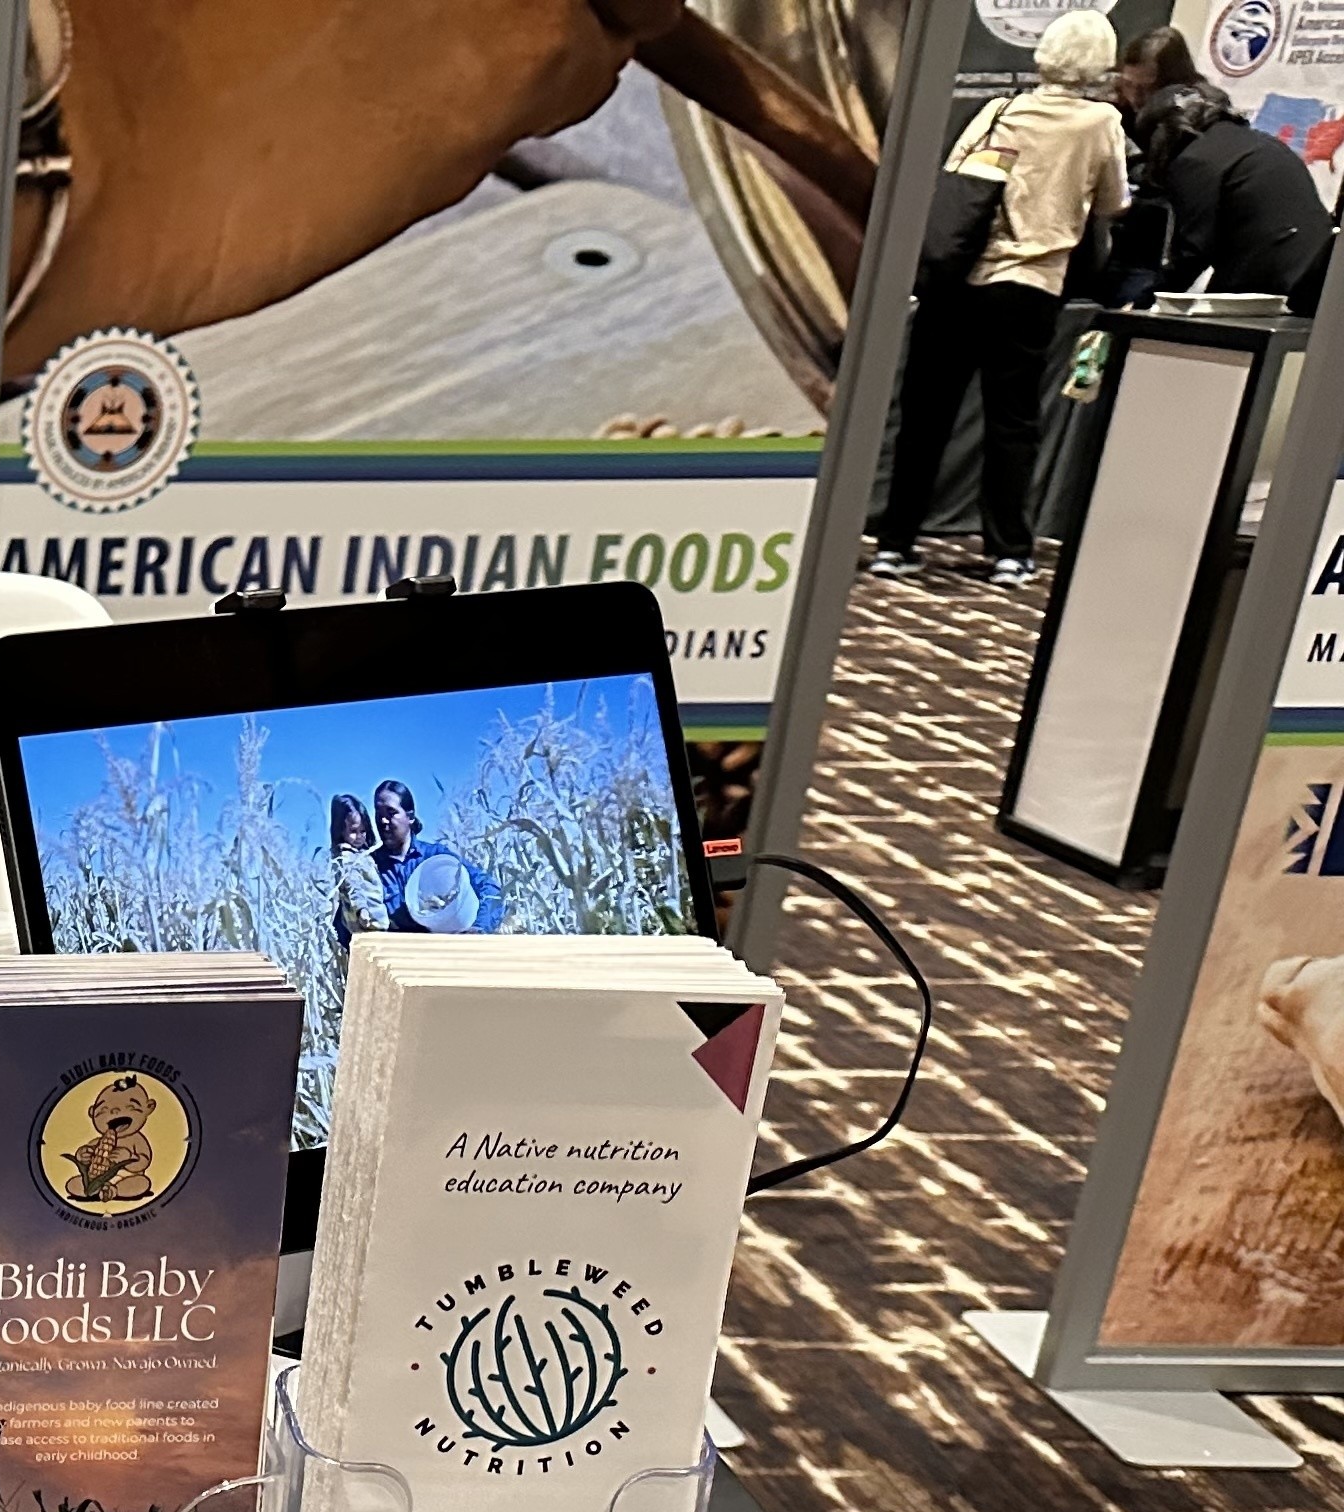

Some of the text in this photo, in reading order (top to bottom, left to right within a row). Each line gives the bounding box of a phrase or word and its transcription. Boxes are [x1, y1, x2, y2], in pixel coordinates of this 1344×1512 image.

[1, 531, 794, 595] AMERICAN INDIAN FOODS
[446, 1133, 680, 1161] A Native nutrition
[445, 1171, 682, 1203] education company
[101, 1257, 213, 1304] Baby
[417, 1259, 664, 1336] TUMBLEWEED
[126, 1304, 216, 1341] LLC
[113, 1357, 161, 1373] Navajo
[70, 1400, 102, 1413] baby
[106, 1399, 135, 1410] food
[140, 1399, 163, 1409] line
[167, 1398, 218, 1409] created
[10, 1417, 61, 1428] farmers
[64, 1417, 90, 1427] and
[95, 1418, 122, 1427] new
[126, 1417, 177, 1430] parents
[181, 1417, 194, 1426] to
[26, 1436, 69, 1444] access
[73, 1434, 87, 1444] to
[91, 1433, 159, 1443] traditional
[163, 1432, 199, 1443] foods
[203, 1433, 215, 1442] in
[36, 1451, 66, 1463] early
[414, 1417, 631, 1476] NUTRITION
